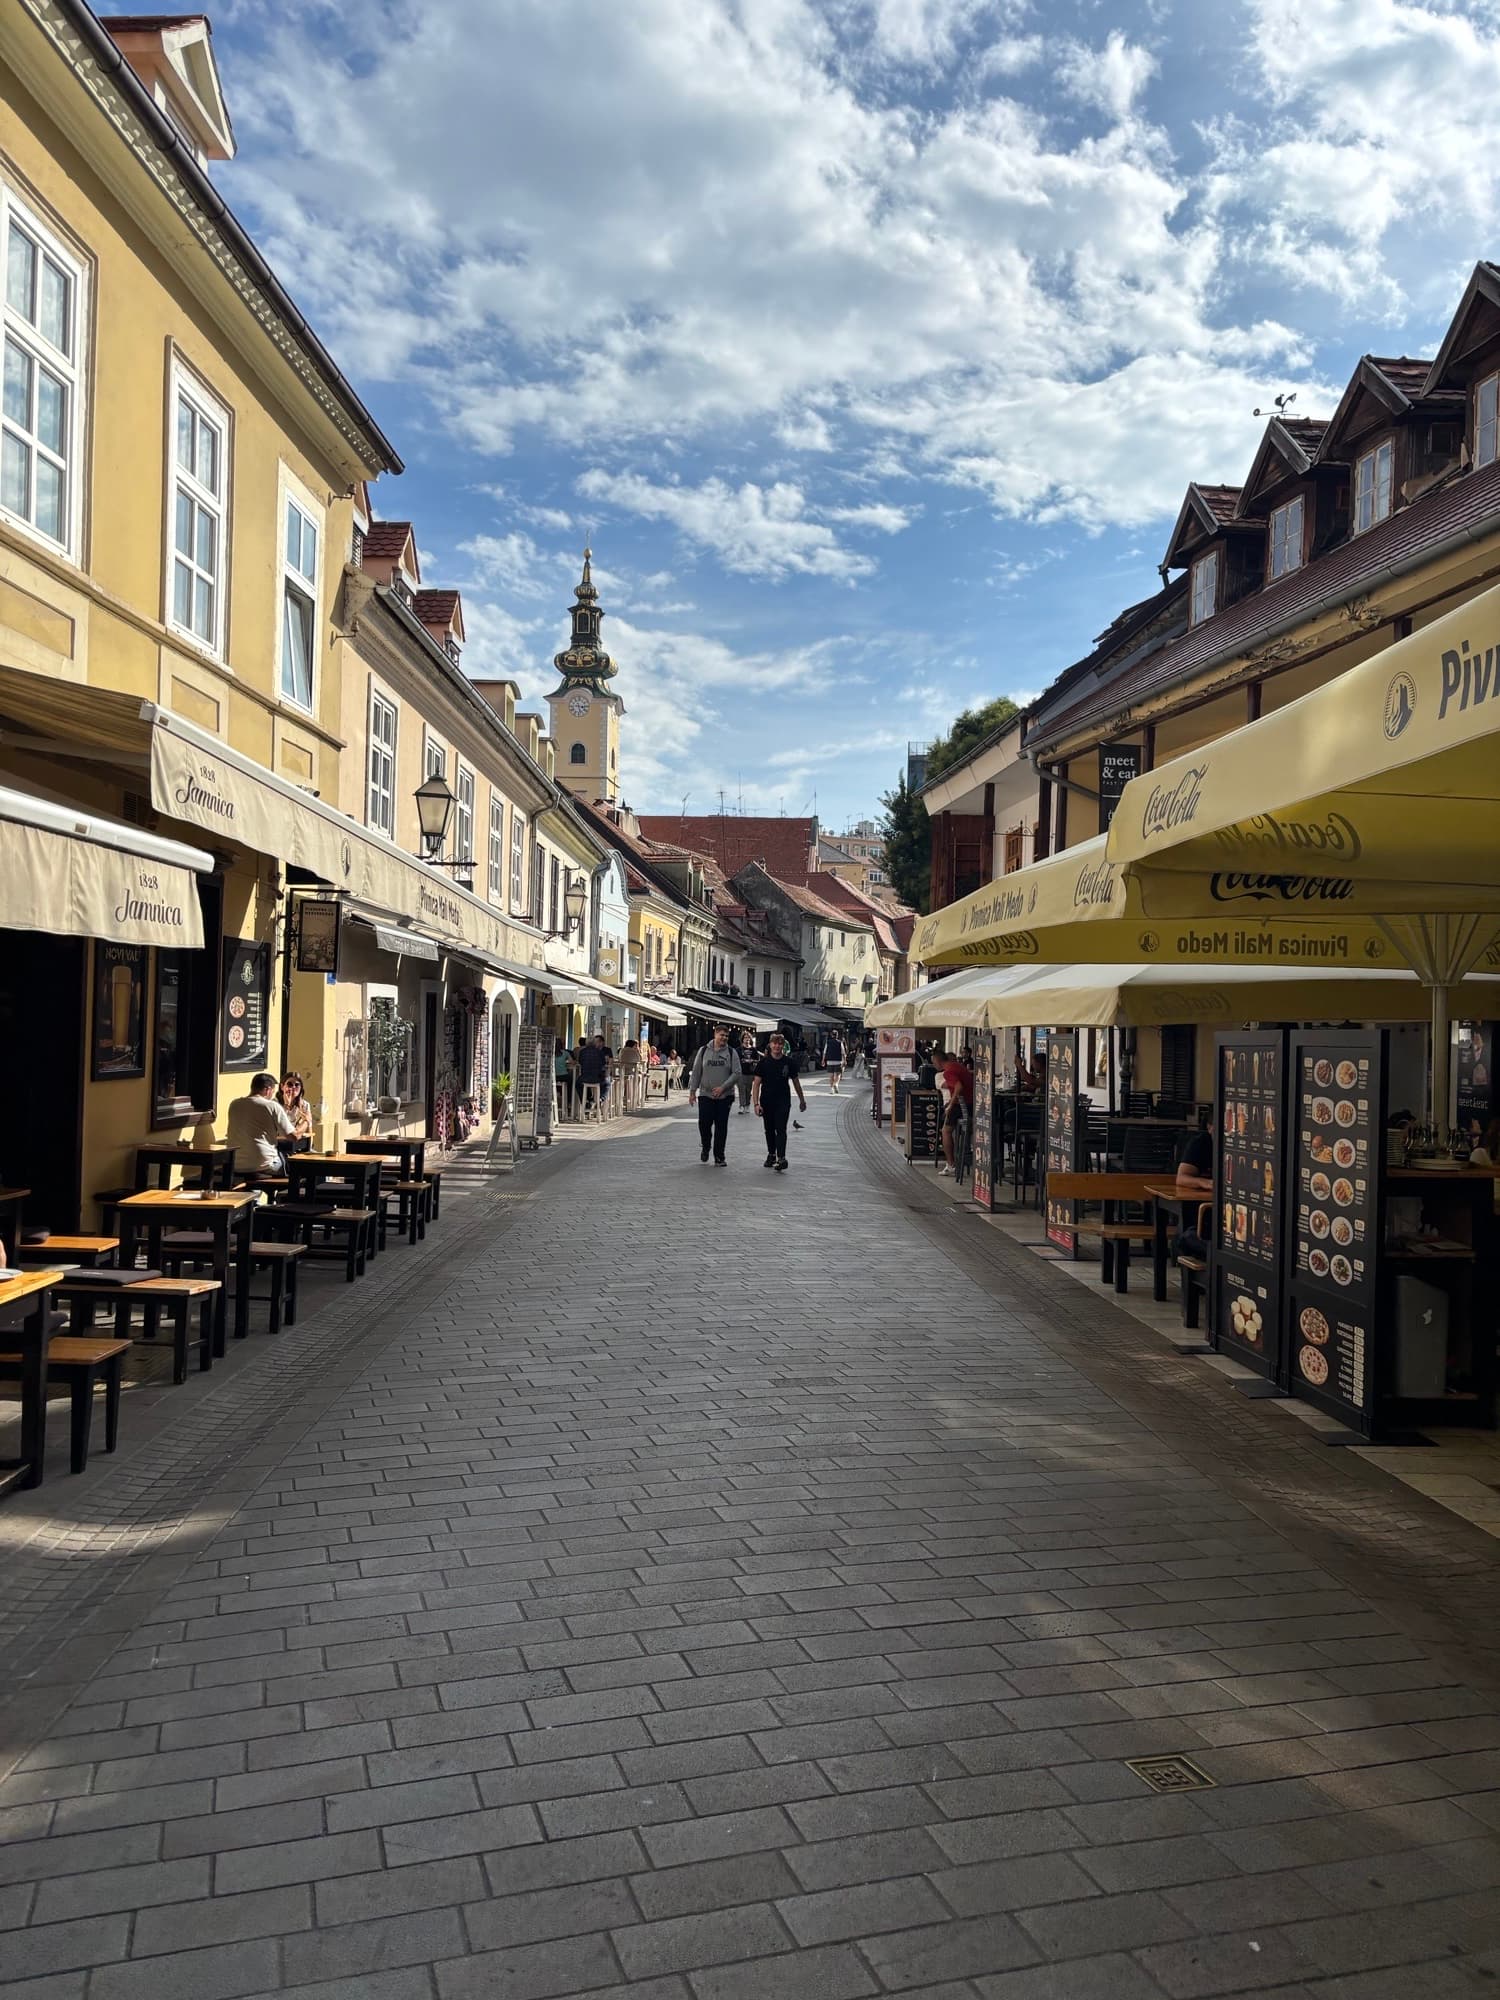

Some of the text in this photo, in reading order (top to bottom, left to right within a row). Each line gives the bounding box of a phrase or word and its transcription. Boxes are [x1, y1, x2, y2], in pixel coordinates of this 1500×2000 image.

[1104, 757, 1135, 767] meet
[200, 765, 216, 784] 1828
[1102, 767, 1137, 779] & eat
[175, 775, 235, 820] Jamnica
[139, 873, 159, 890] 1828
[115, 888, 183, 926] Jamnica
[969, 887, 1024, 931] Pivnica Mali Medo
